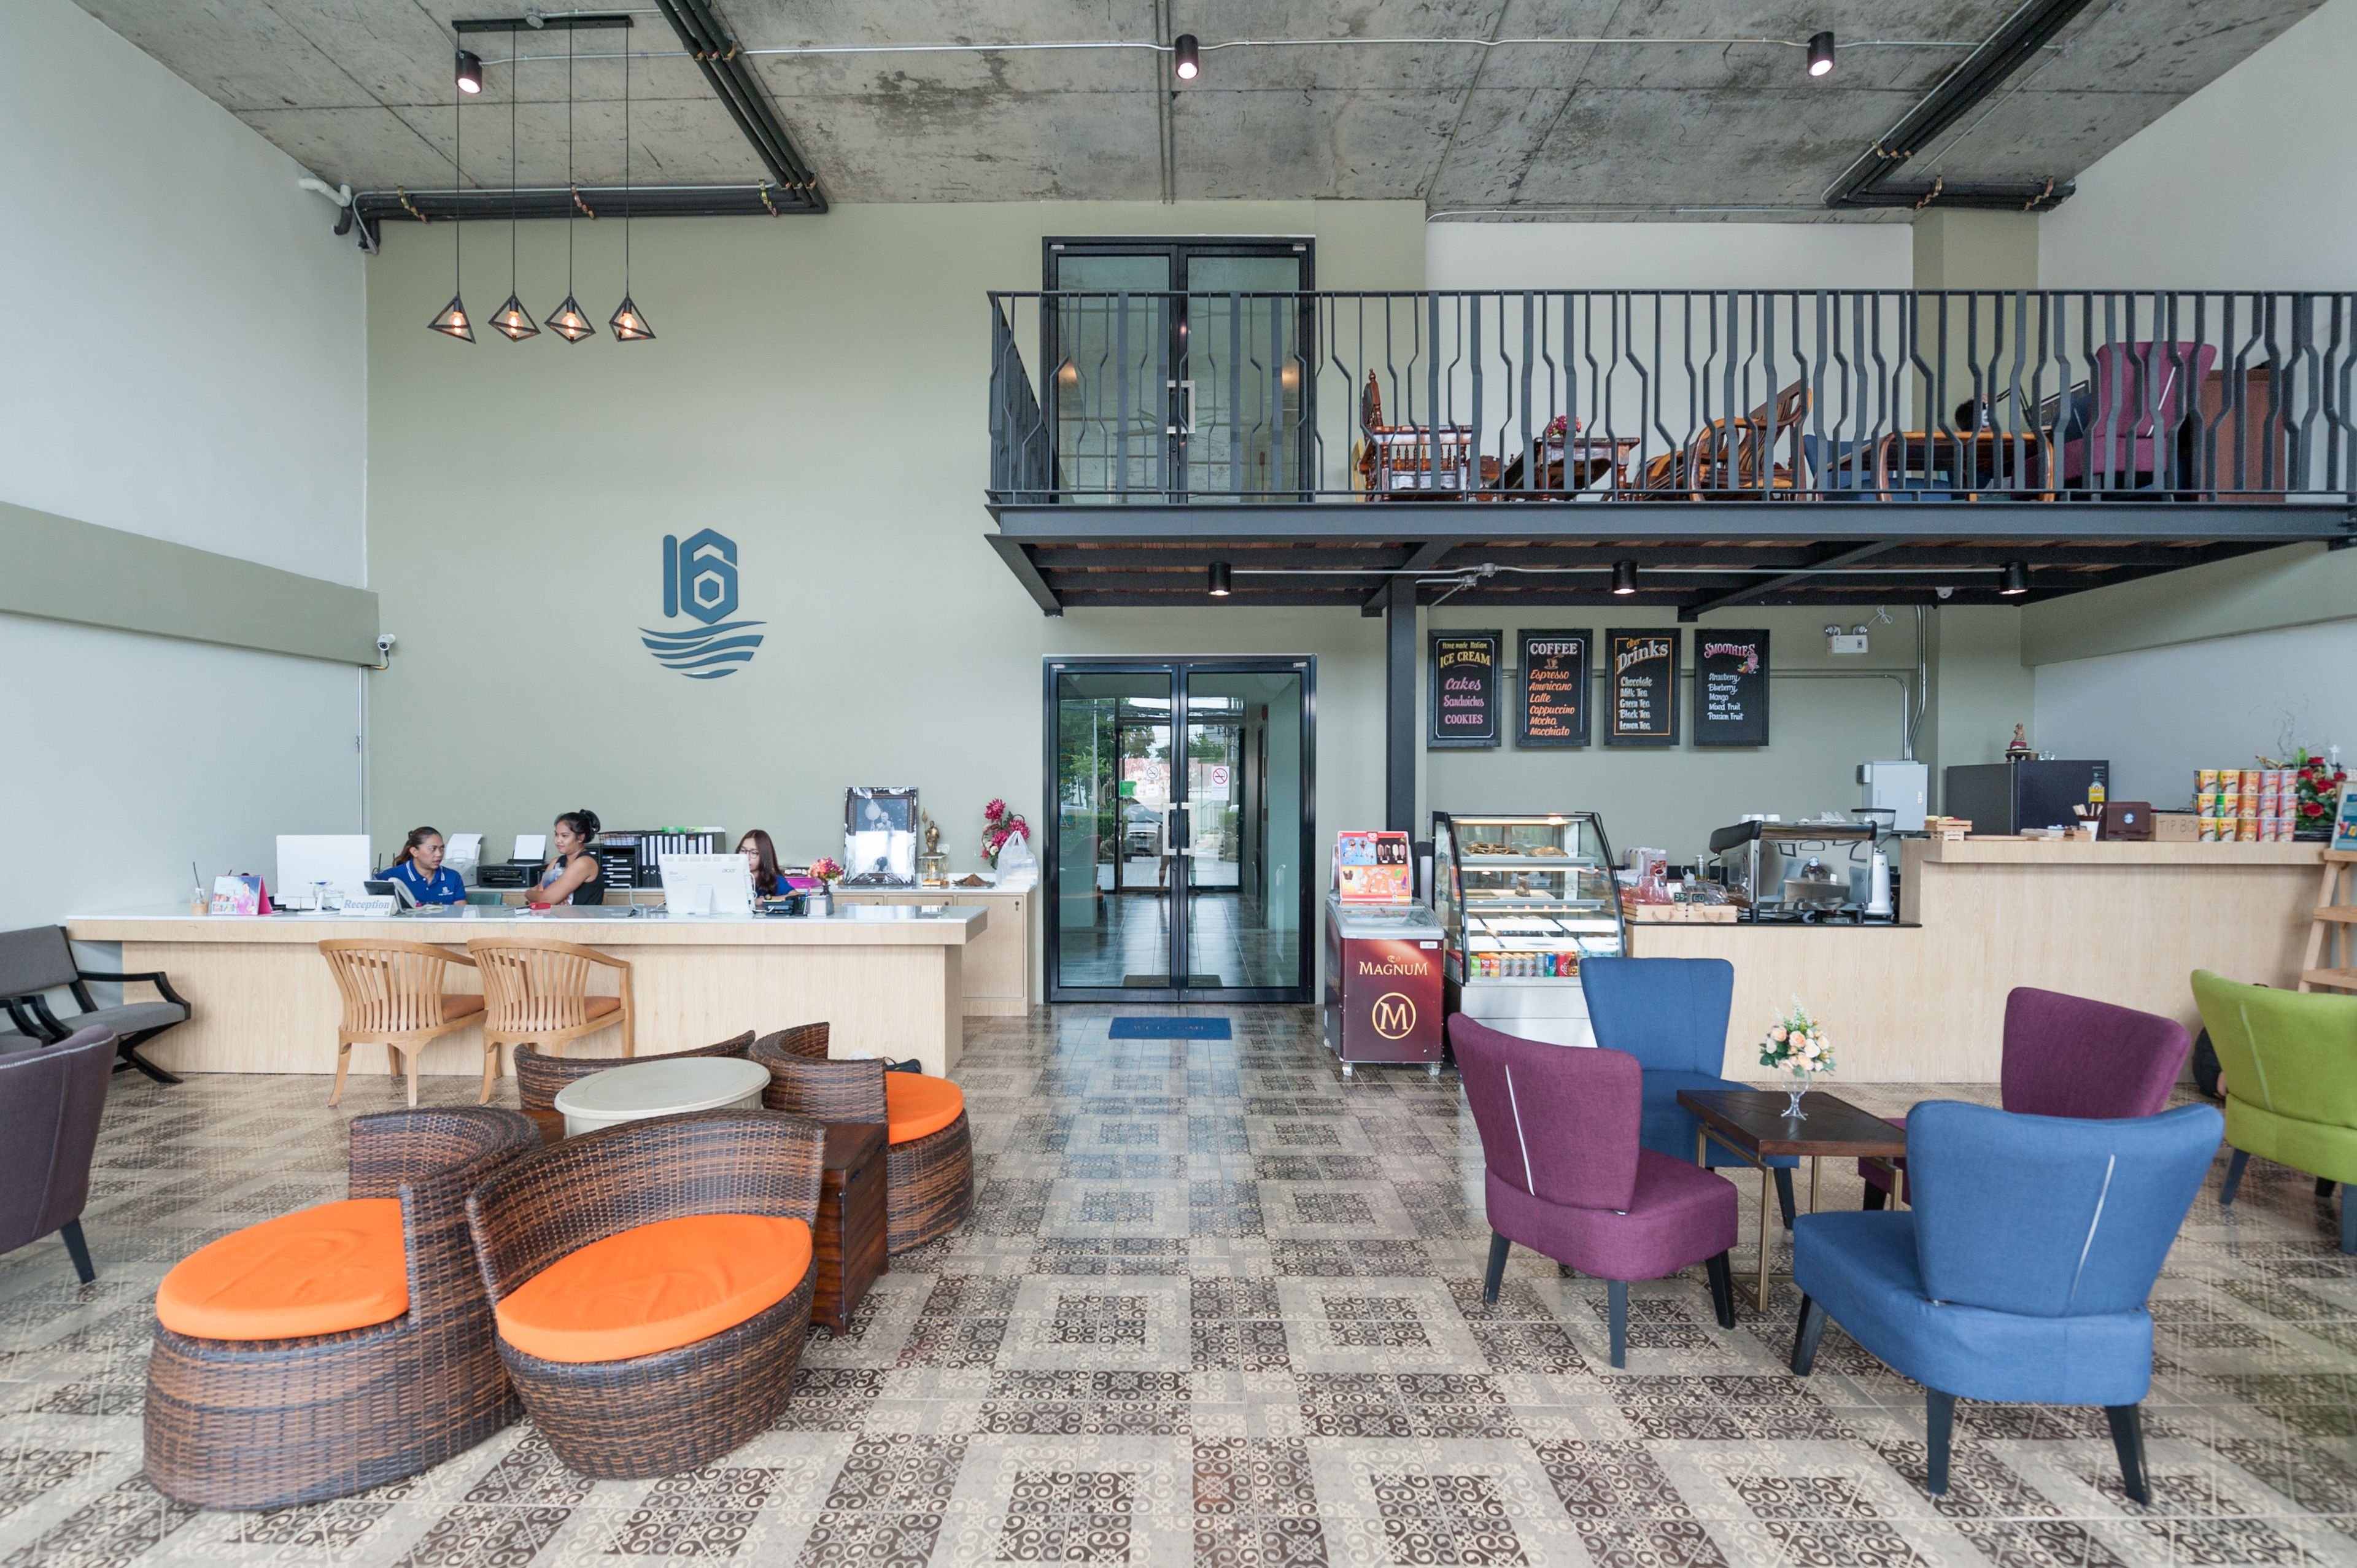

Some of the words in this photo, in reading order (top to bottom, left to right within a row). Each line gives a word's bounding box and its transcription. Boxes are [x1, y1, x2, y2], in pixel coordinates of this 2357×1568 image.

[1530, 643, 1577, 655] COFFEE
[1704, 643, 1755, 658] SMOOTHIES
[1440, 652, 1455, 668] ICE
[1457, 651, 1491, 666] CREAM
[1616, 640, 1668, 674] Drinks
[1530, 669, 1569, 681] Espresso
[1709, 673, 1741, 684] Strawberry
[1444, 677, 1482, 690] Cakes
[1529, 681, 1573, 691] Americano
[1620, 676, 1652, 687] Chocolate
[1620, 688, 1636, 698] Milk
[1636, 688, 1647, 697] Tea
[1707, 684, 1738, 695] Blueberry
[1444, 695, 1484, 707] Sandwiches
[1530, 692, 1551, 703] Latte
[1619, 698, 1638, 708] Green
[1639, 699, 1651, 708] Tea
[1709, 693, 1728, 703] Mango
[1530, 704, 1575, 716] Cappuccino
[1728, 702, 1741, 711] Fruit
[1445, 714, 1484, 725] COOKIES
[1619, 709, 1638, 719] Black
[1639, 710, 1651, 719] Tea
[1530, 716, 1558, 725] Mocha
[1619, 720, 1639, 730] Lemon
[1639, 721, 1651, 730] Tea
[1530, 725, 1570, 736] Macchiato
[2158, 819, 2176, 832] TIP
[344, 899, 390, 911] Reception
[1359, 961, 1428, 976] MAGNUM
[1380, 1002, 1409, 1030] M
